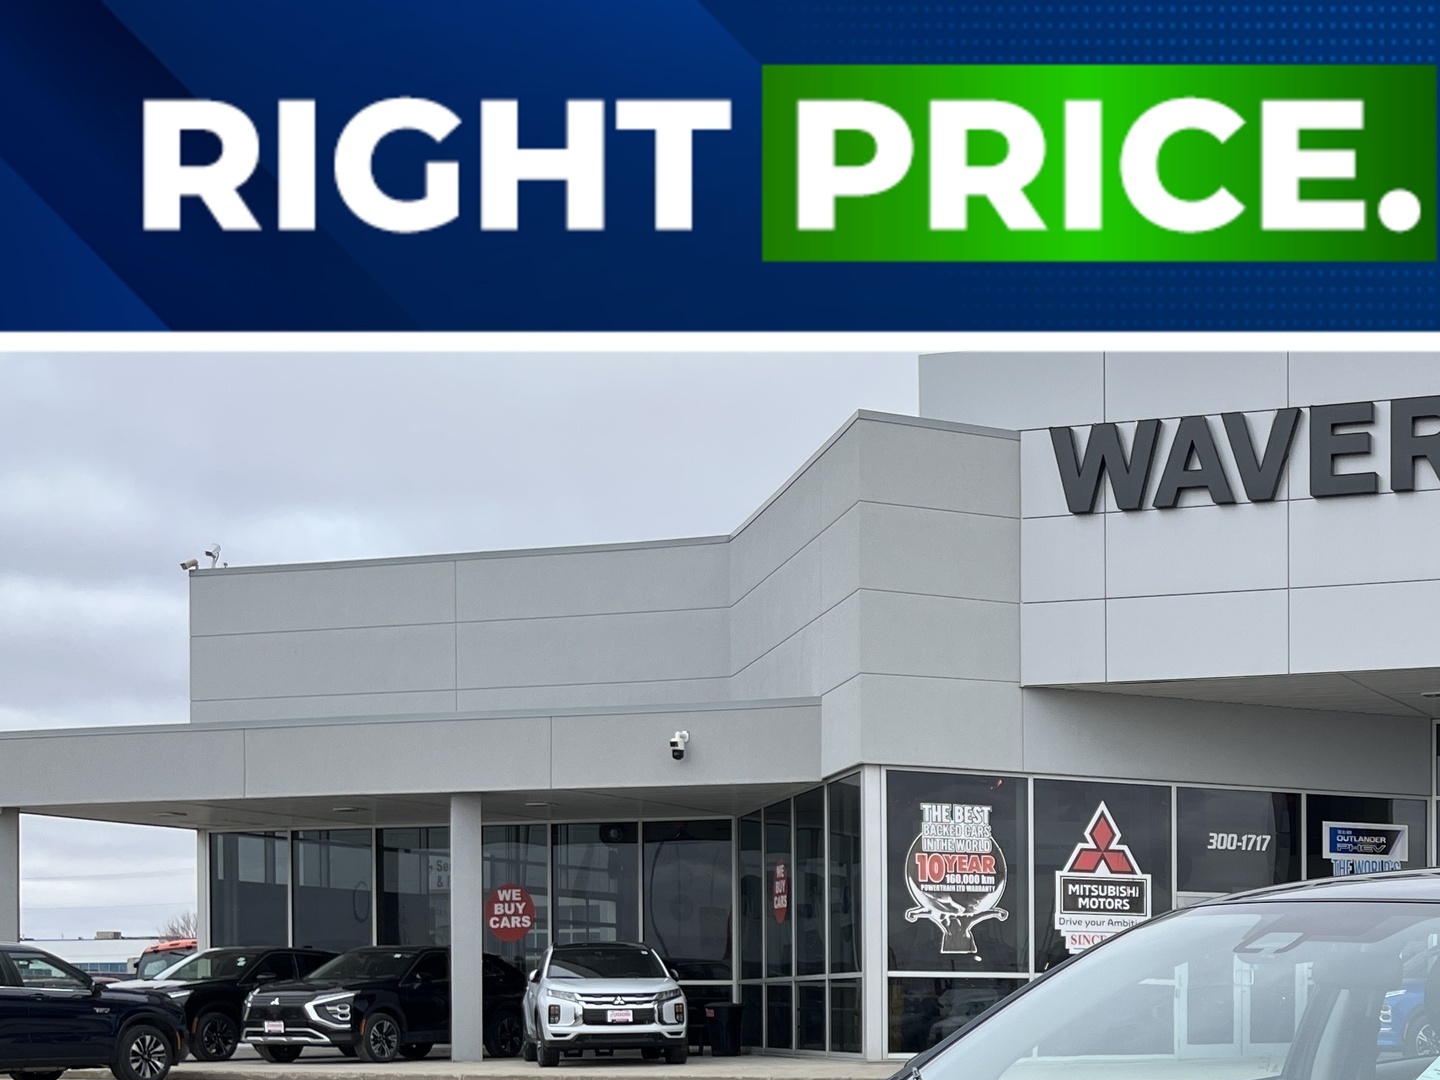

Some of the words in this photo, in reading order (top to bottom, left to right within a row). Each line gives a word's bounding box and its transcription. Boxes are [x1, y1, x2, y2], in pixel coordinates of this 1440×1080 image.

[921, 803, 952, 824] THE
[953, 804, 992, 825] BEST
[922, 824, 962, 838] BACKED
[962, 825, 992, 838] CARS
[922, 838, 935, 852] IN
[935, 838, 955, 852] THE
[955, 838, 992, 853] WORLD
[1207, 832, 1272, 852] 300-1717
[1336, 835, 1387, 844] OUTLANDER
[1336, 843, 1387, 853] PHEV
[915, 853, 945, 883] 10
[944, 854, 997, 874] YEAR
[981, 875, 995, 885] km
[497, 888, 522, 901] WE
[1068, 884, 1139, 898] MITSUBISHI
[773, 894, 787, 909] CARS
[1078, 897, 1131, 910] MOTORS
[493, 902, 526, 916] BUY
[489, 915, 532, 929] CARS
[1059, 917, 1083, 926] Drive
[1085, 919, 1106, 929] your
